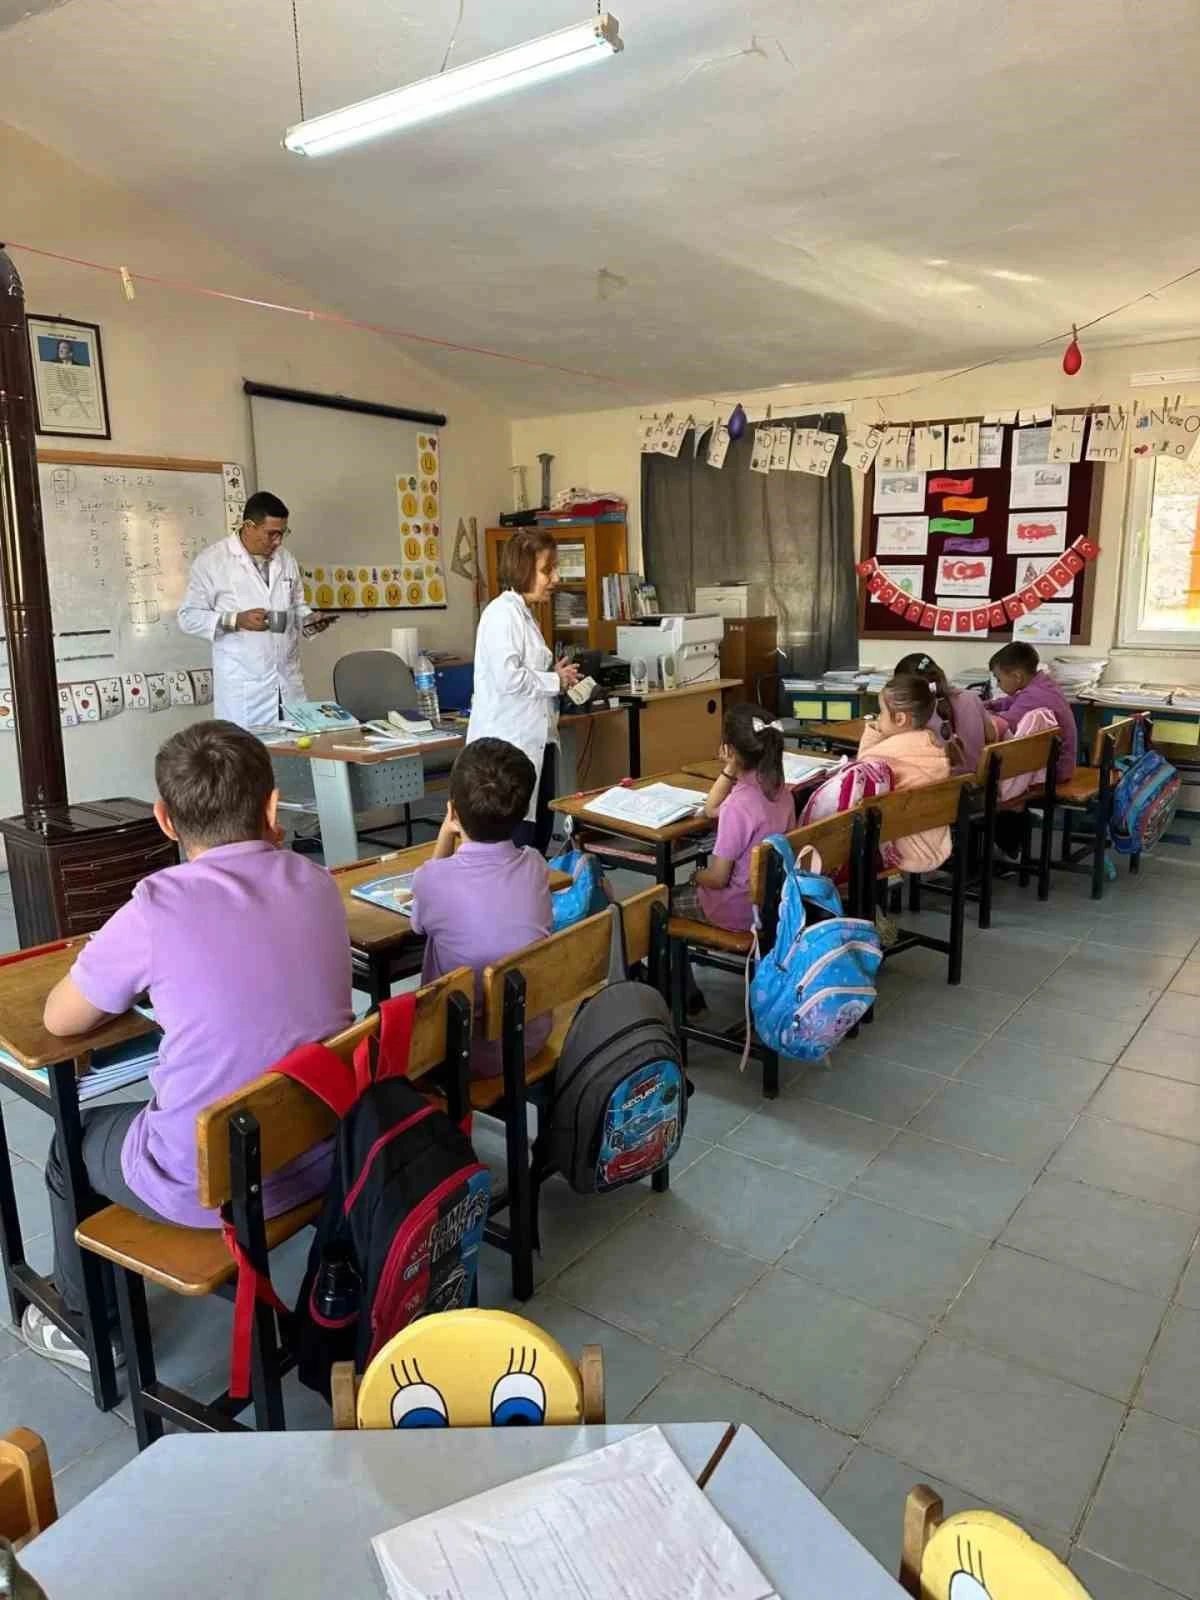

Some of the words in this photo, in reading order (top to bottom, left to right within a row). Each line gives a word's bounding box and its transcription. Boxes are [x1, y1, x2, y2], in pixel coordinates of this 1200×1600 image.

[1071, 416, 1081, 433] L
[1106, 415, 1125, 431] M
[1150, 408, 1165, 426] N
[1184, 415, 1200, 433] O
[763, 432, 772, 449] D
[1104, 447, 1118, 457] m
